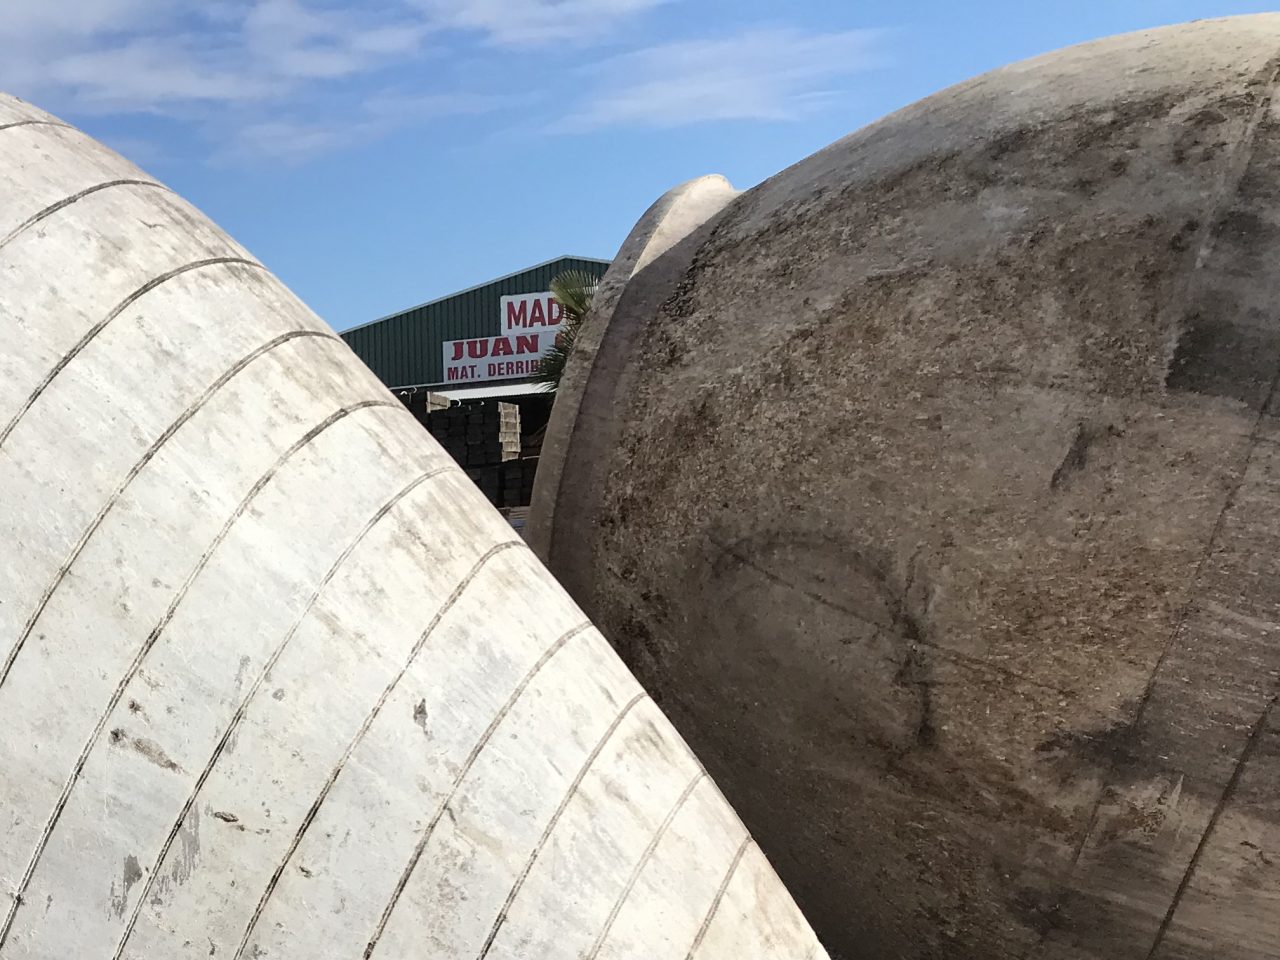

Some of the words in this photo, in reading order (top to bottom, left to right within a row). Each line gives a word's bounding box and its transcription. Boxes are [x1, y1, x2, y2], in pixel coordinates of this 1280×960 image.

[451, 334, 539, 361] JUAN
[447, 364, 481, 381] MAT.
[487, 360, 543, 377] DERRIB
